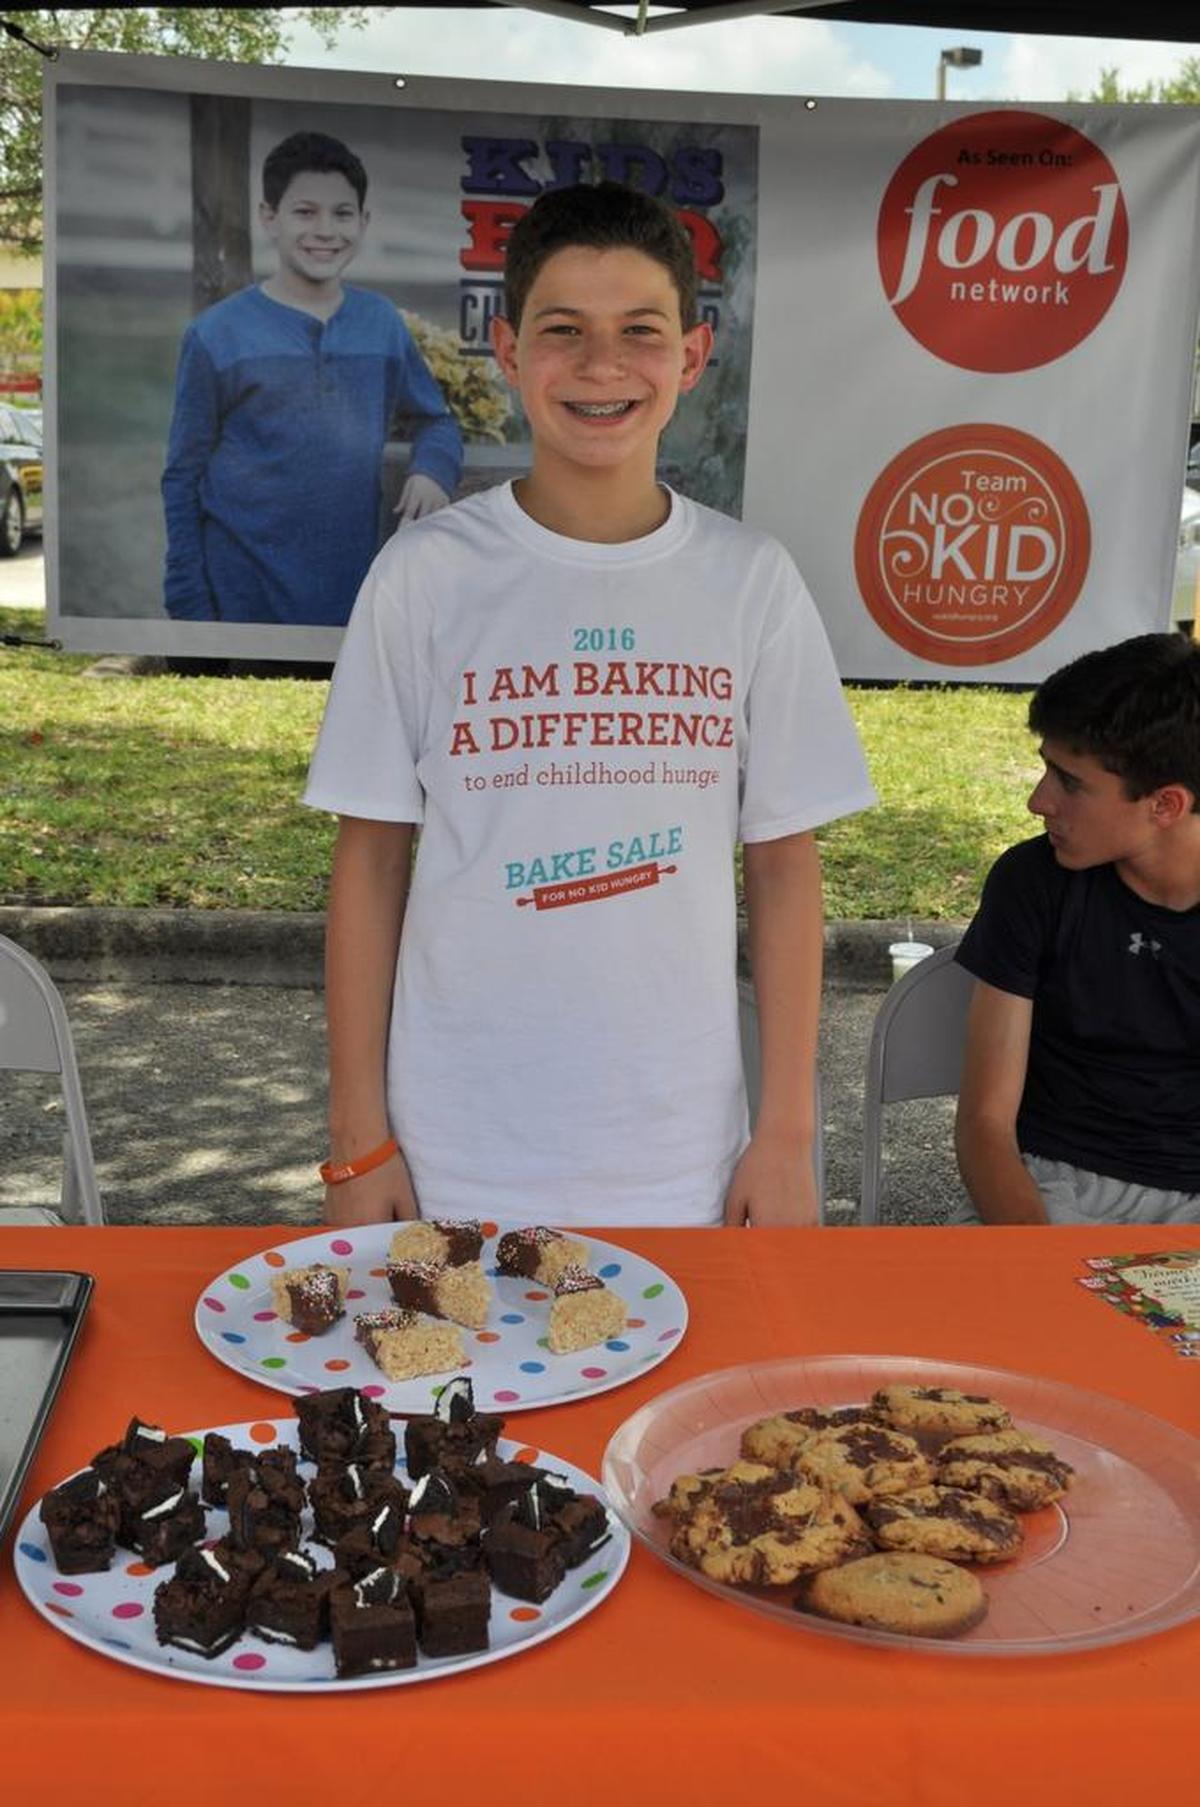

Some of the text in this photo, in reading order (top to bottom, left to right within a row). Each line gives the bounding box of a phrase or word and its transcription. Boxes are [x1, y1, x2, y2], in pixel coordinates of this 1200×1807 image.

[460, 135, 725, 208] KIDS
[957, 149, 1073, 168] As Seen On:
[888, 173, 1120, 307] food
[950, 279, 1069, 305] network
[961, 470, 1027, 492] Team
[908, 492, 975, 527] NO
[931, 523, 1057, 582] KID
[902, 583, 1030, 606] HUNGRY
[573, 628, 636, 651] 2016
[463, 661, 733, 705] I AM BAKING
[449, 711, 734, 756] A DIFFERENCE
[465, 761, 720, 791] to end childhood hunge
[505, 825, 684, 890] BAKE SALE
[541, 871, 653, 904] FOR NO KID HUNGRY
